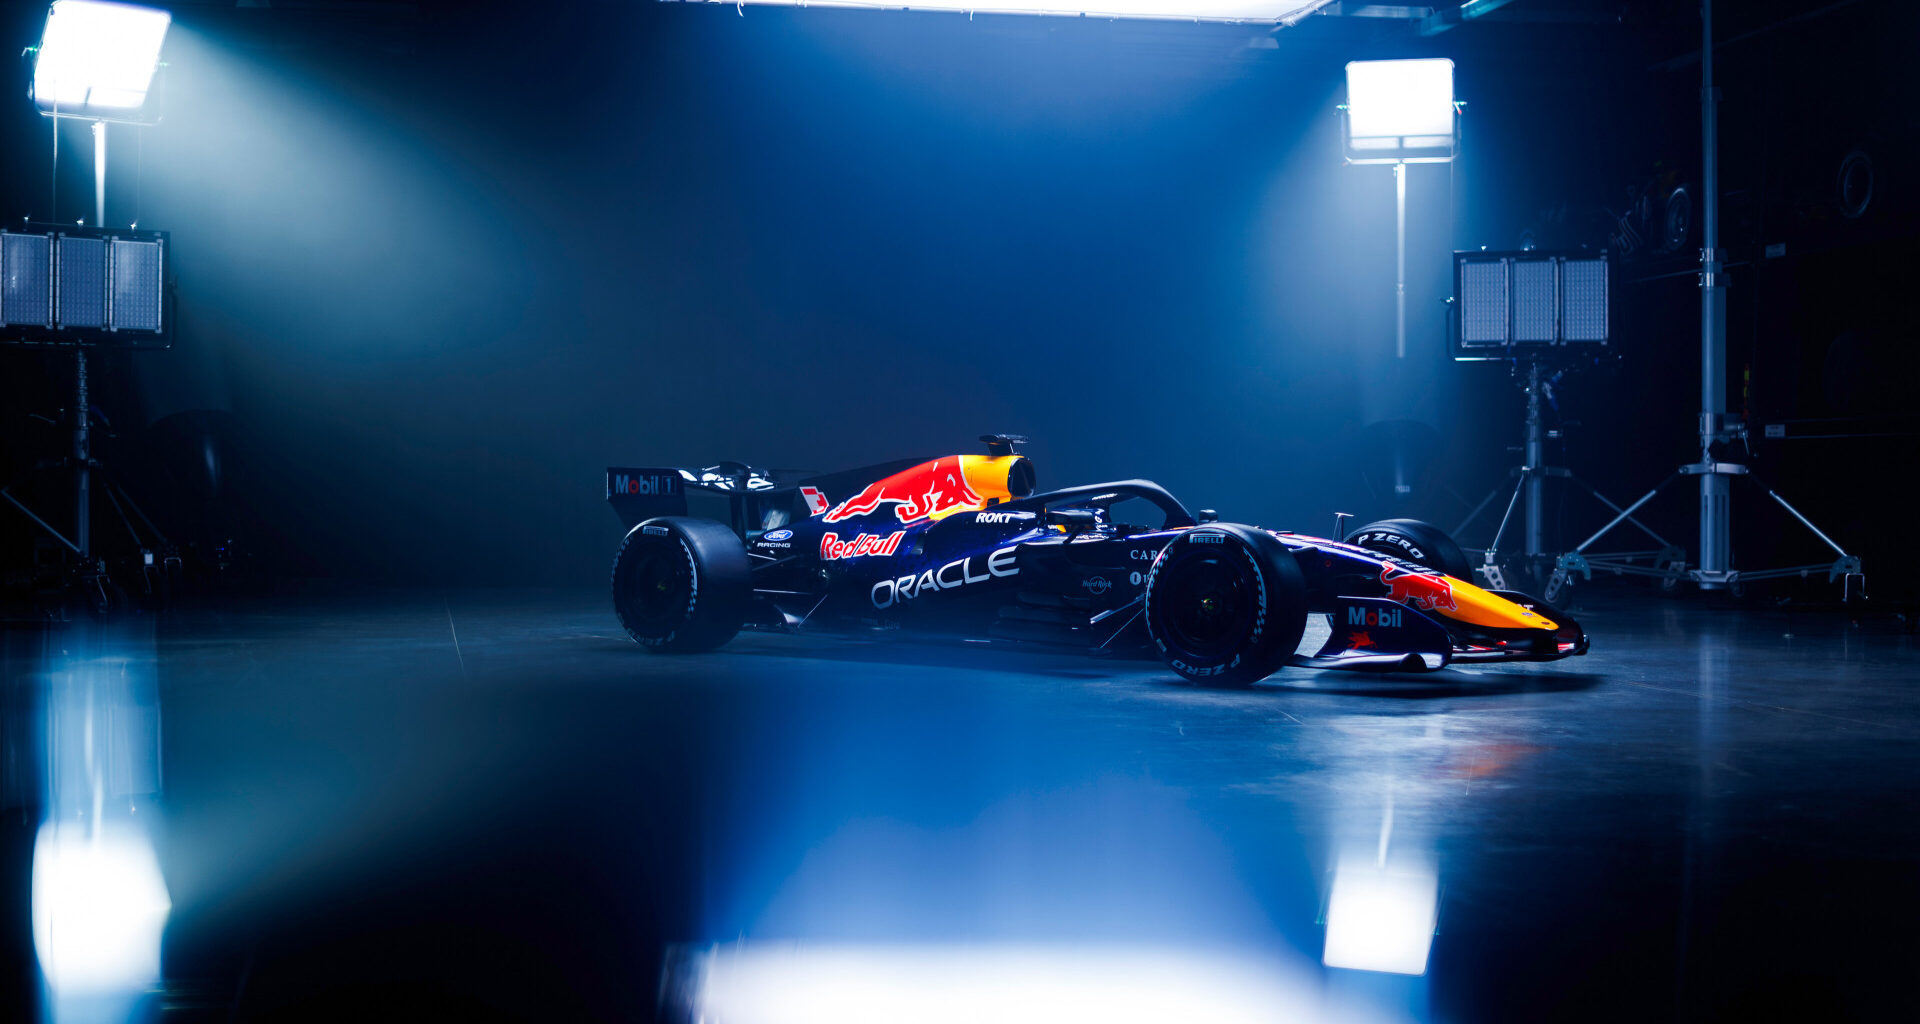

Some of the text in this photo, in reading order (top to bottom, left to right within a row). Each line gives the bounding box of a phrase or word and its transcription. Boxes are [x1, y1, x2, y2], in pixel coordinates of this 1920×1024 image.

[615, 474, 659, 495] Mobil
[975, 512, 1013, 524] ROKT
[1189, 534, 1225, 544] PIRELLI
[1358, 533, 1424, 559] P ZERO
[871, 545, 1021, 610] ORACLE
[1348, 607, 1401, 628] Mobil
[1172, 659, 1225, 676] ZERO
